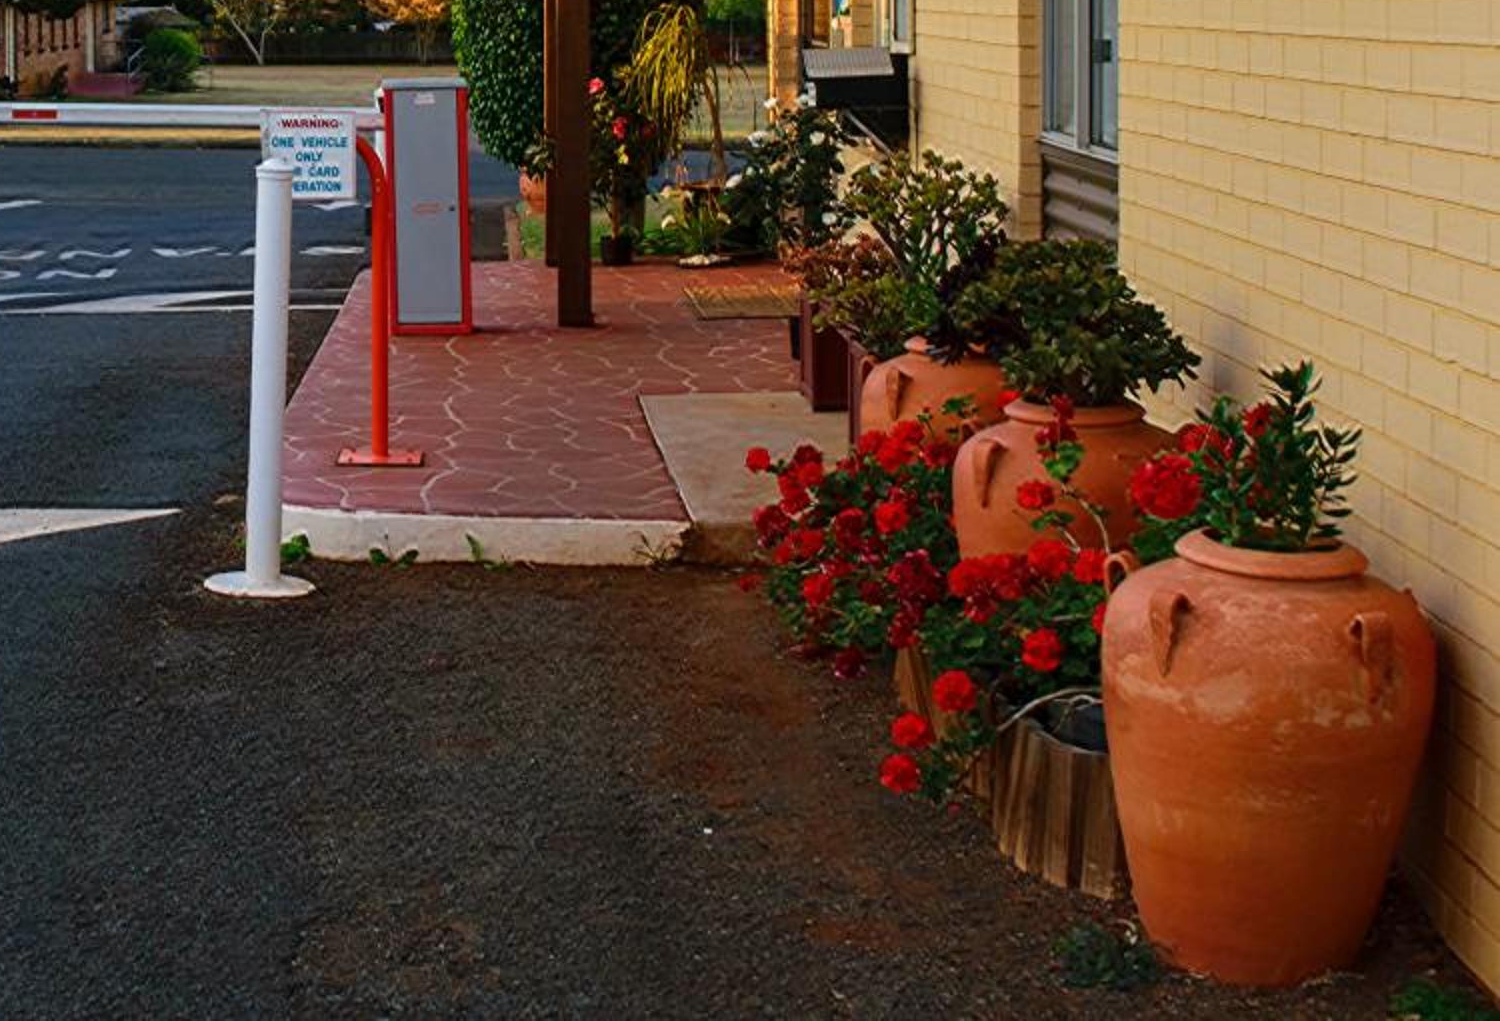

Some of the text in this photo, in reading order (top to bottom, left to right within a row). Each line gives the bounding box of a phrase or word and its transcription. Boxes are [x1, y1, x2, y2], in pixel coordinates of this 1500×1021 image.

[281, 119, 339, 128] WARNING
[272, 137, 348, 147] ONE VEHICLE
[296, 152, 322, 161] ONLY
[308, 166, 340, 177] CARD
[292, 181, 342, 192] ERATION
